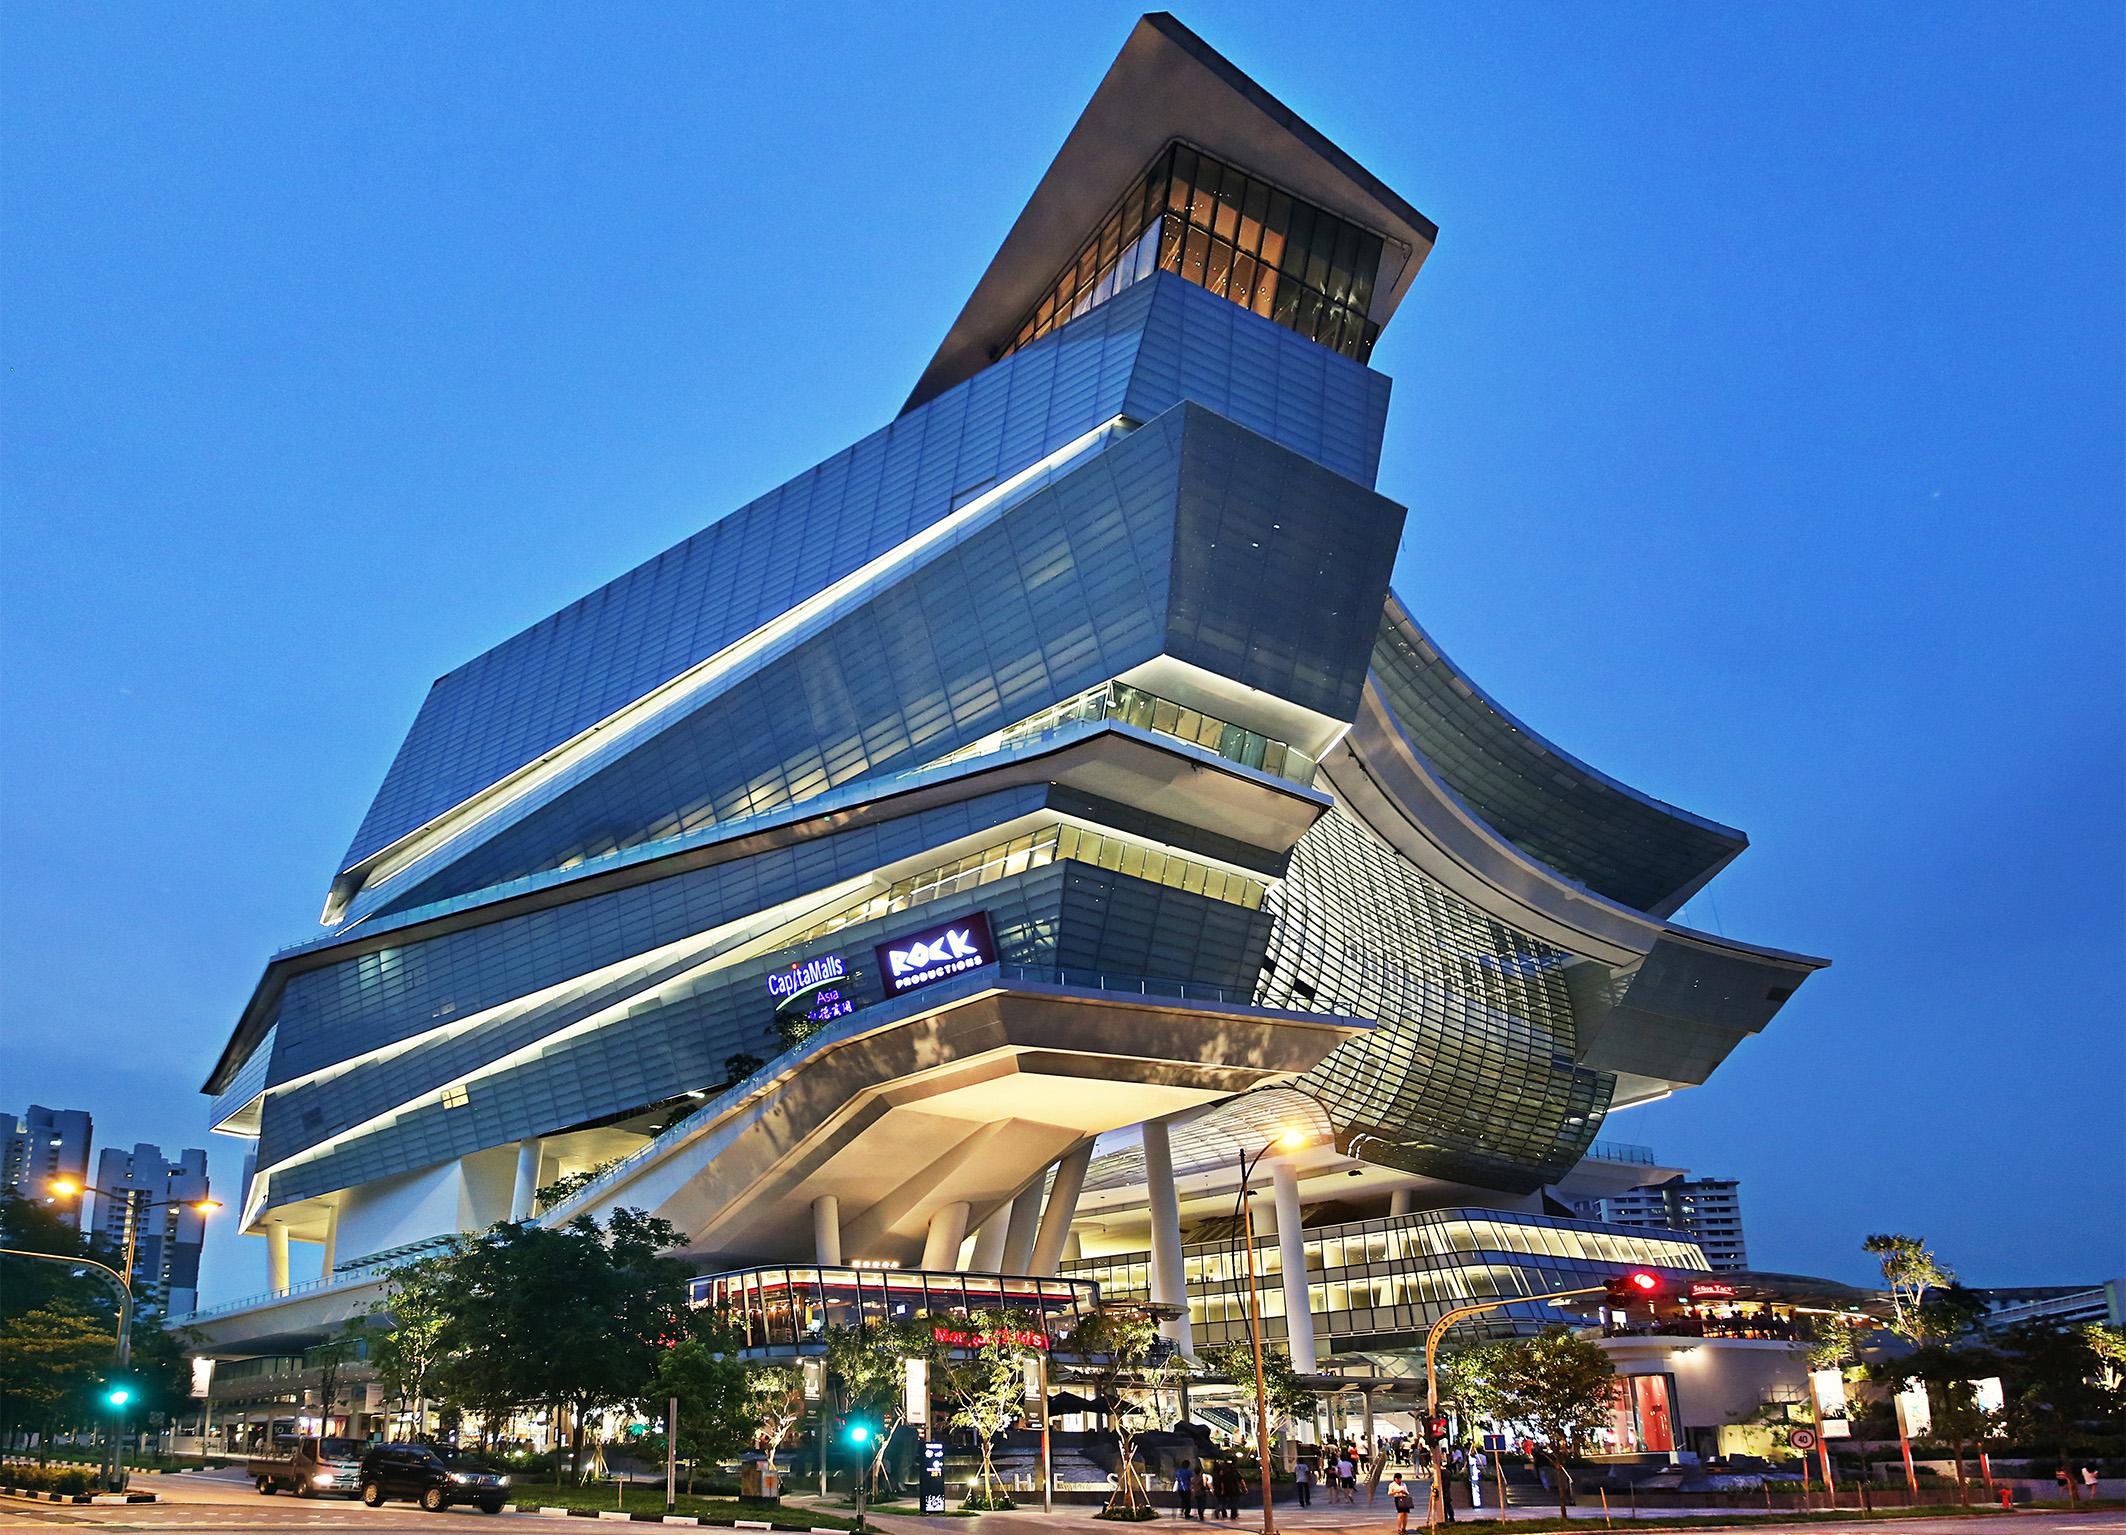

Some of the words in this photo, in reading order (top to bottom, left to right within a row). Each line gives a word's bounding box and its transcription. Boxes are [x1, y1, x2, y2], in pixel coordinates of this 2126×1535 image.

[889, 929, 978, 976] ROCK
[767, 956, 844, 996] CapitaMalls
[895, 955, 983, 989] PRODUCTIONS
[816, 988, 839, 1004] Asia
[1799, 1435, 1808, 1443] 40
